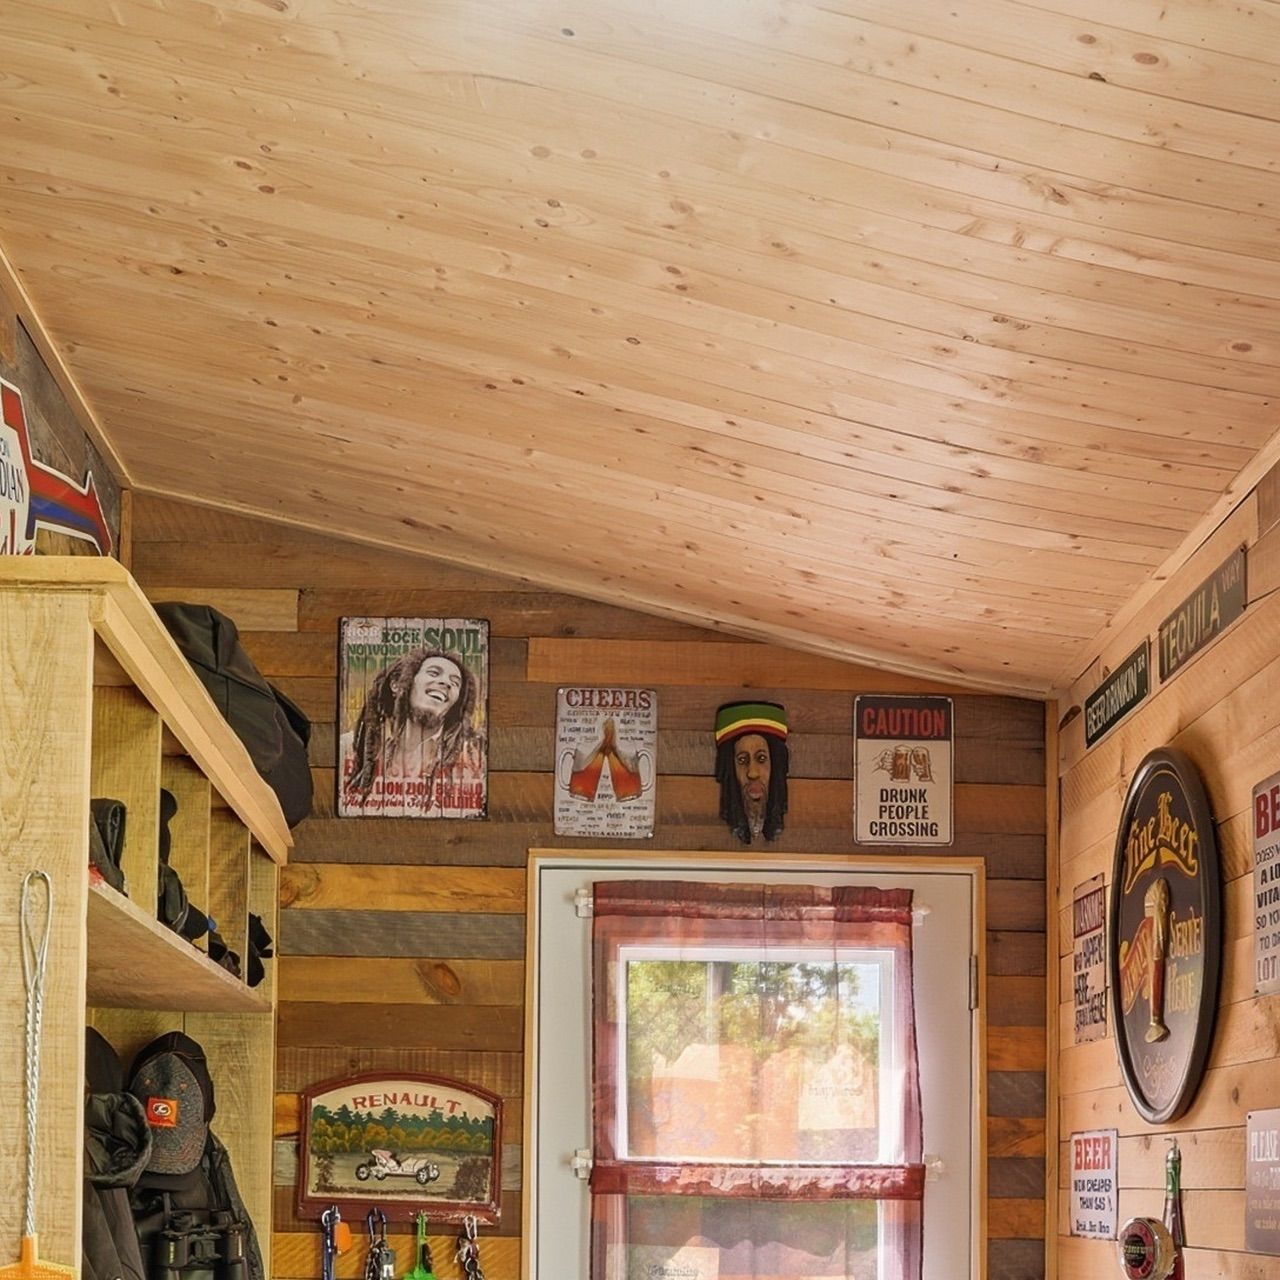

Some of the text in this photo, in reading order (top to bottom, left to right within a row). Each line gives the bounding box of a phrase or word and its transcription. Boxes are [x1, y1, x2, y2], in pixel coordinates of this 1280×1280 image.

[1161, 558, 1241, 676] TEQUILA WAY
[424, 628, 484, 655] SOUL
[566, 689, 652, 711] CHEERS
[862, 708, 946, 737] CAUTION
[880, 788, 928, 804] DRUNK
[879, 805, 929, 820] PEOPLE
[869, 821, 939, 837] CROSSING
[1261, 866, 1268, 885] A
[1256, 910, 1267, 930] SO
[1260, 932, 1270, 950] TO
[1257, 953, 1276, 981] LOT
[352, 1092, 462, 1114] RENAULT
[1074, 1135, 1111, 1171] BEER
[1251, 1130, 1280, 1162] PLEASE
